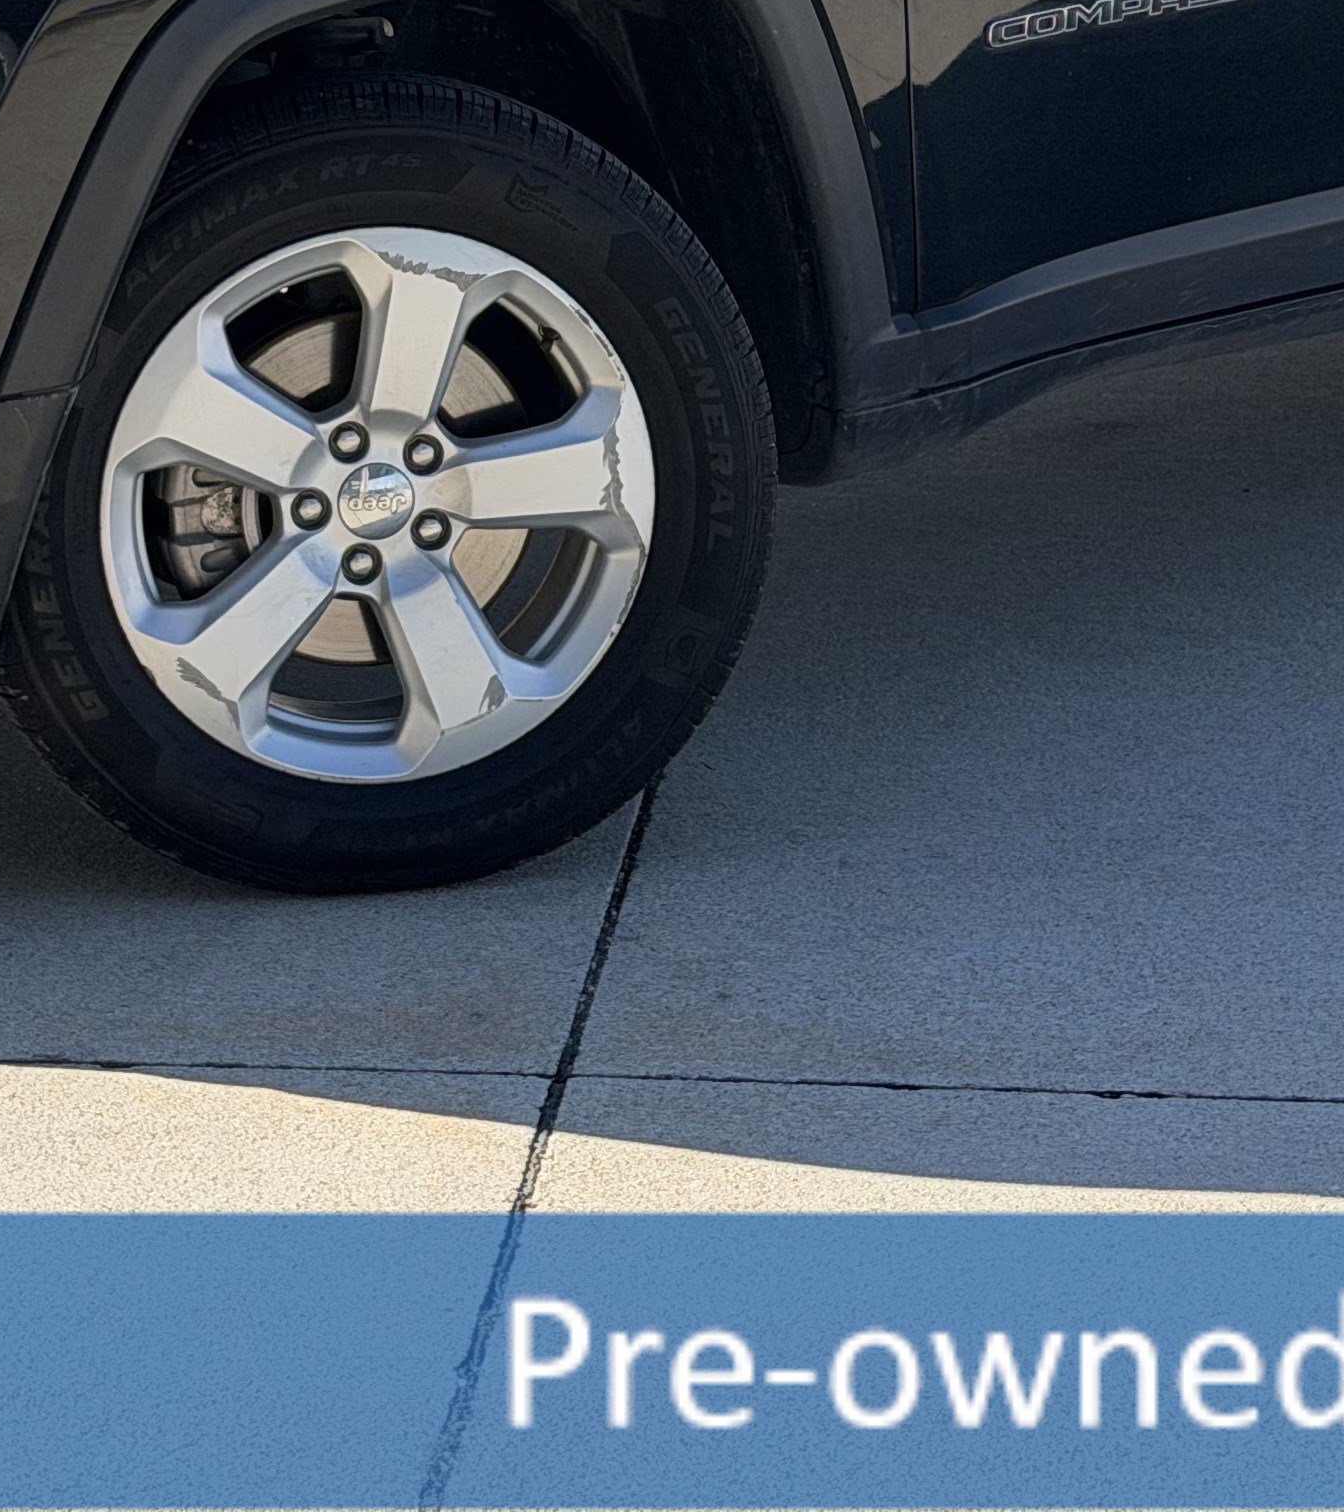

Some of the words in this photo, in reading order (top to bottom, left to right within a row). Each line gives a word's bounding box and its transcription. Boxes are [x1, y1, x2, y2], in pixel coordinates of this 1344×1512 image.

[124, 167, 300, 298] ALTIMAX
[346, 490, 408, 515] Jeep
[653, 296, 735, 552] GENERAL
[24, 480, 110, 722] GENERA
